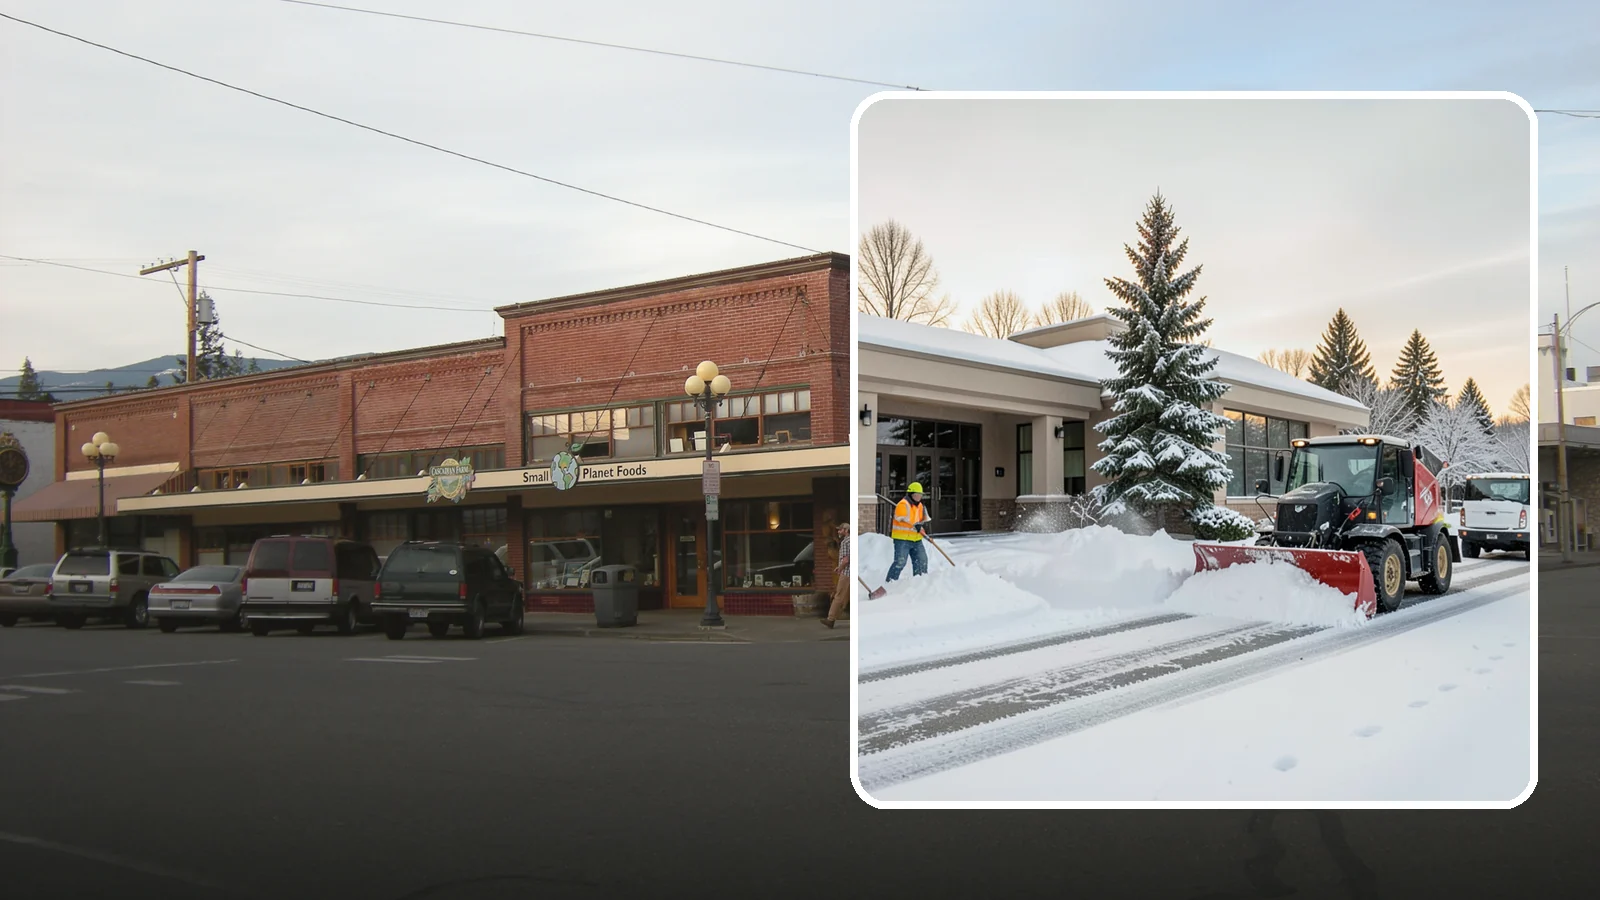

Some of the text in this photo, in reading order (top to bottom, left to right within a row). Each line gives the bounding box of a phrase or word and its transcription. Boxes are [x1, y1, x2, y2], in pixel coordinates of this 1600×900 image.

[523, 464, 647, 483] Small Planet Foods
